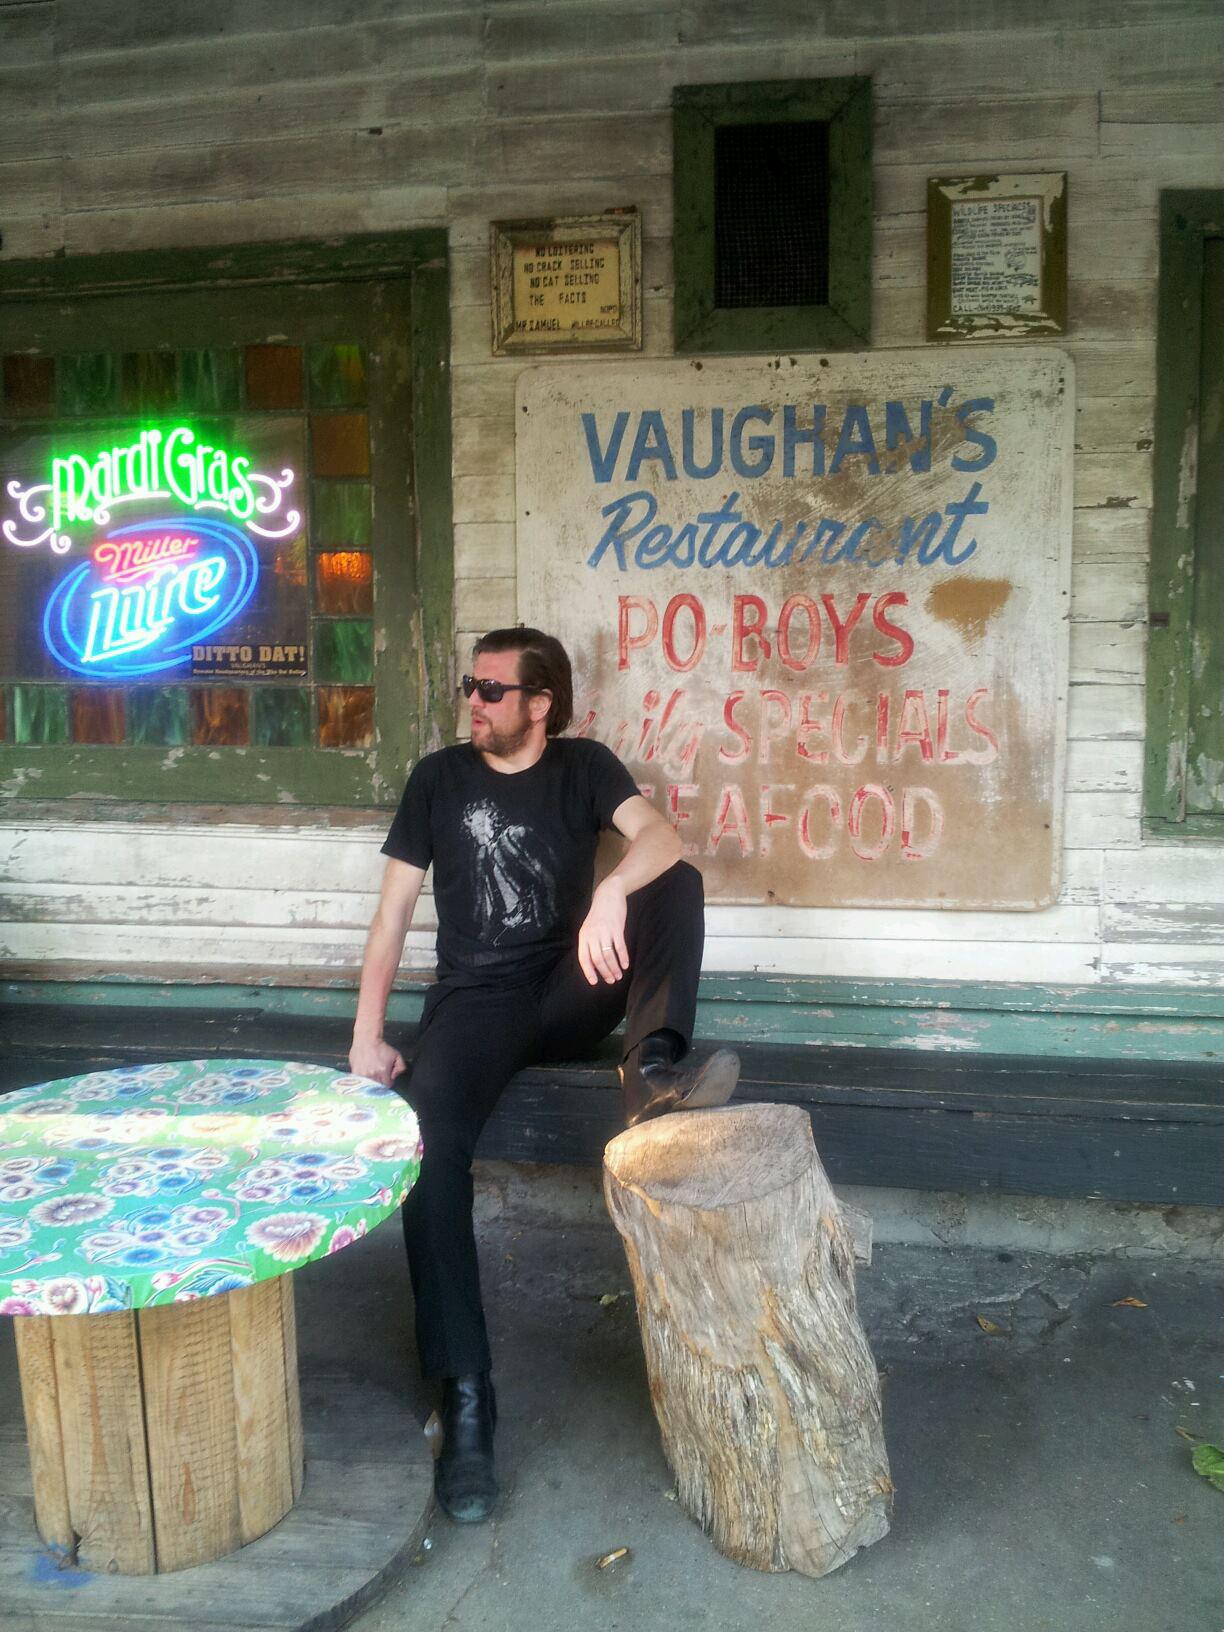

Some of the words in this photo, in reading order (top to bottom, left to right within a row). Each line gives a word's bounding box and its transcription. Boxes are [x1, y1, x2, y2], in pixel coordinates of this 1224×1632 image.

[523, 262, 534, 273] NO
[536, 260, 562, 272] CRACK
[570, 258, 605, 270] SELLING
[535, 244, 546, 257] NO
[548, 243, 595, 257] LOITERING
[529, 276, 540, 288] NO
[542, 275, 559, 288] CAT
[564, 273, 600, 286] SELLING
[529, 294, 544, 306] THE
[559, 291, 587, 304] FACTS
[581, 386, 998, 483] VAUGHAN'S
[52, 429, 170, 529] Mardi
[163, 427, 255, 518] Gras
[94, 536, 200, 575] Miller
[586, 482, 990, 572] Restaurant
[192, 646, 252, 662] DITTO
[259, 646, 304, 662] DAT!
[617, 592, 916, 672] PO-BOYS
[718, 688, 1000, 766] SPECIALS
[638, 782, 945, 862] EAFOOD
